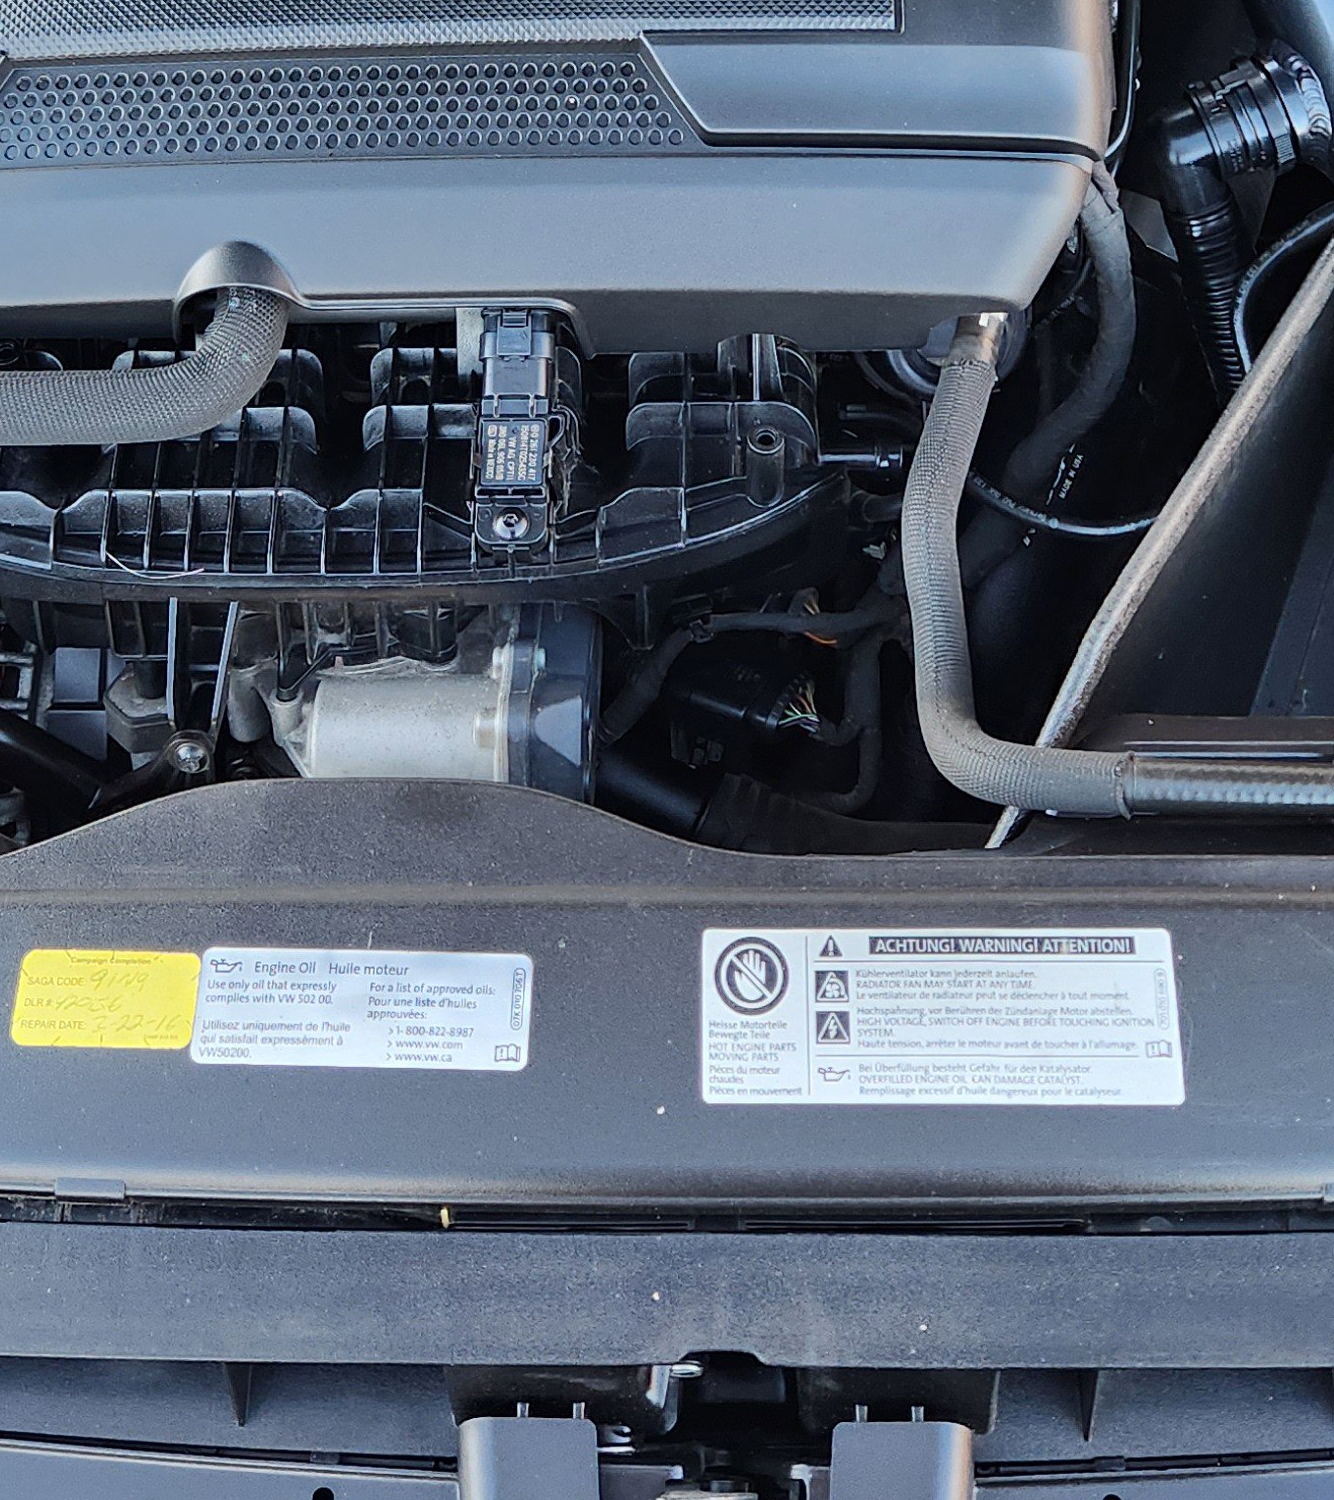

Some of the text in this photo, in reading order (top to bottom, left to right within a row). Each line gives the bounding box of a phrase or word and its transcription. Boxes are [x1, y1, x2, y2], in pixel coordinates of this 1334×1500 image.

[875, 938, 1130, 953] ACHTUNG! WARNING! ATTENTION!
[255, 961, 409, 976] Engine Oil Huile moteur
[28, 977, 55, 985] SAGA
[857, 980, 901, 988] RADIATOR
[904, 980, 921, 988] FAN
[925, 980, 943, 988] MAY
[947, 980, 973, 988] START
[976, 980, 987, 988] AT
[990, 980, 1007, 988] ANY
[207, 980, 337, 993] Use only oil that expressly
[370, 982, 496, 996] For a list of approved oils:
[24, 998, 42, 1007] DLR
[205, 993, 334, 1004] complies with VW 502 00.
[368, 997, 391, 1006] Pour
[394, 999, 412, 1007] une
[415, 998, 435, 1008] liste
[367, 1009, 427, 1021] approuvées:
[21, 1020, 56, 1029] REPAIR
[708, 1020, 788, 1029] Heisse Motorteile
[857, 1018, 882, 1026] HIGH
[928, 1018, 964, 1026] SWITCH
[967, 1018, 983, 1026] OFF
[986, 1018, 1020, 1026] ENGINE
[1023, 1018, 1058, 1026] BEFORE
[1059, 1018, 1109, 1027] TOUCHING
[1112, 1018, 1155, 1027] IGNITION
[202, 1020, 239, 1030] Utilisez
[242, 1021, 303, 1035] uniquement
[305, 1022, 318, 1031] de
[708, 1029, 770, 1041] Bewegte Teile
[200, 1034, 216, 1045] qui
[218, 1034, 257, 1044] satisfait
[336, 1036, 343, 1046] à
[395, 1040, 463, 1049] www.vw.com
[858, 1040, 886, 1048] Haute
[958, 1040, 966, 1048] le
[1004, 1041, 1029, 1049] avant
[1031, 1041, 1042, 1049] de
[1044, 1041, 1080, 1049] toucher
[709, 1043, 797, 1051] HOT ENGINE PARTS
[199, 1047, 252, 1058] VW50200.
[394, 1053, 452, 1063] www.vw.ca
[709, 1053, 779, 1062] MOVING PARTS
[859, 1063, 872, 1072] Bei
[859, 1075, 912, 1084] OVERFILLED
[915, 1075, 950, 1084] ENGINE
[972, 1075, 991, 1084] CAN
[994, 1075, 1035, 1084] DAMAGE
[1065, 1087, 1072, 1095] le
